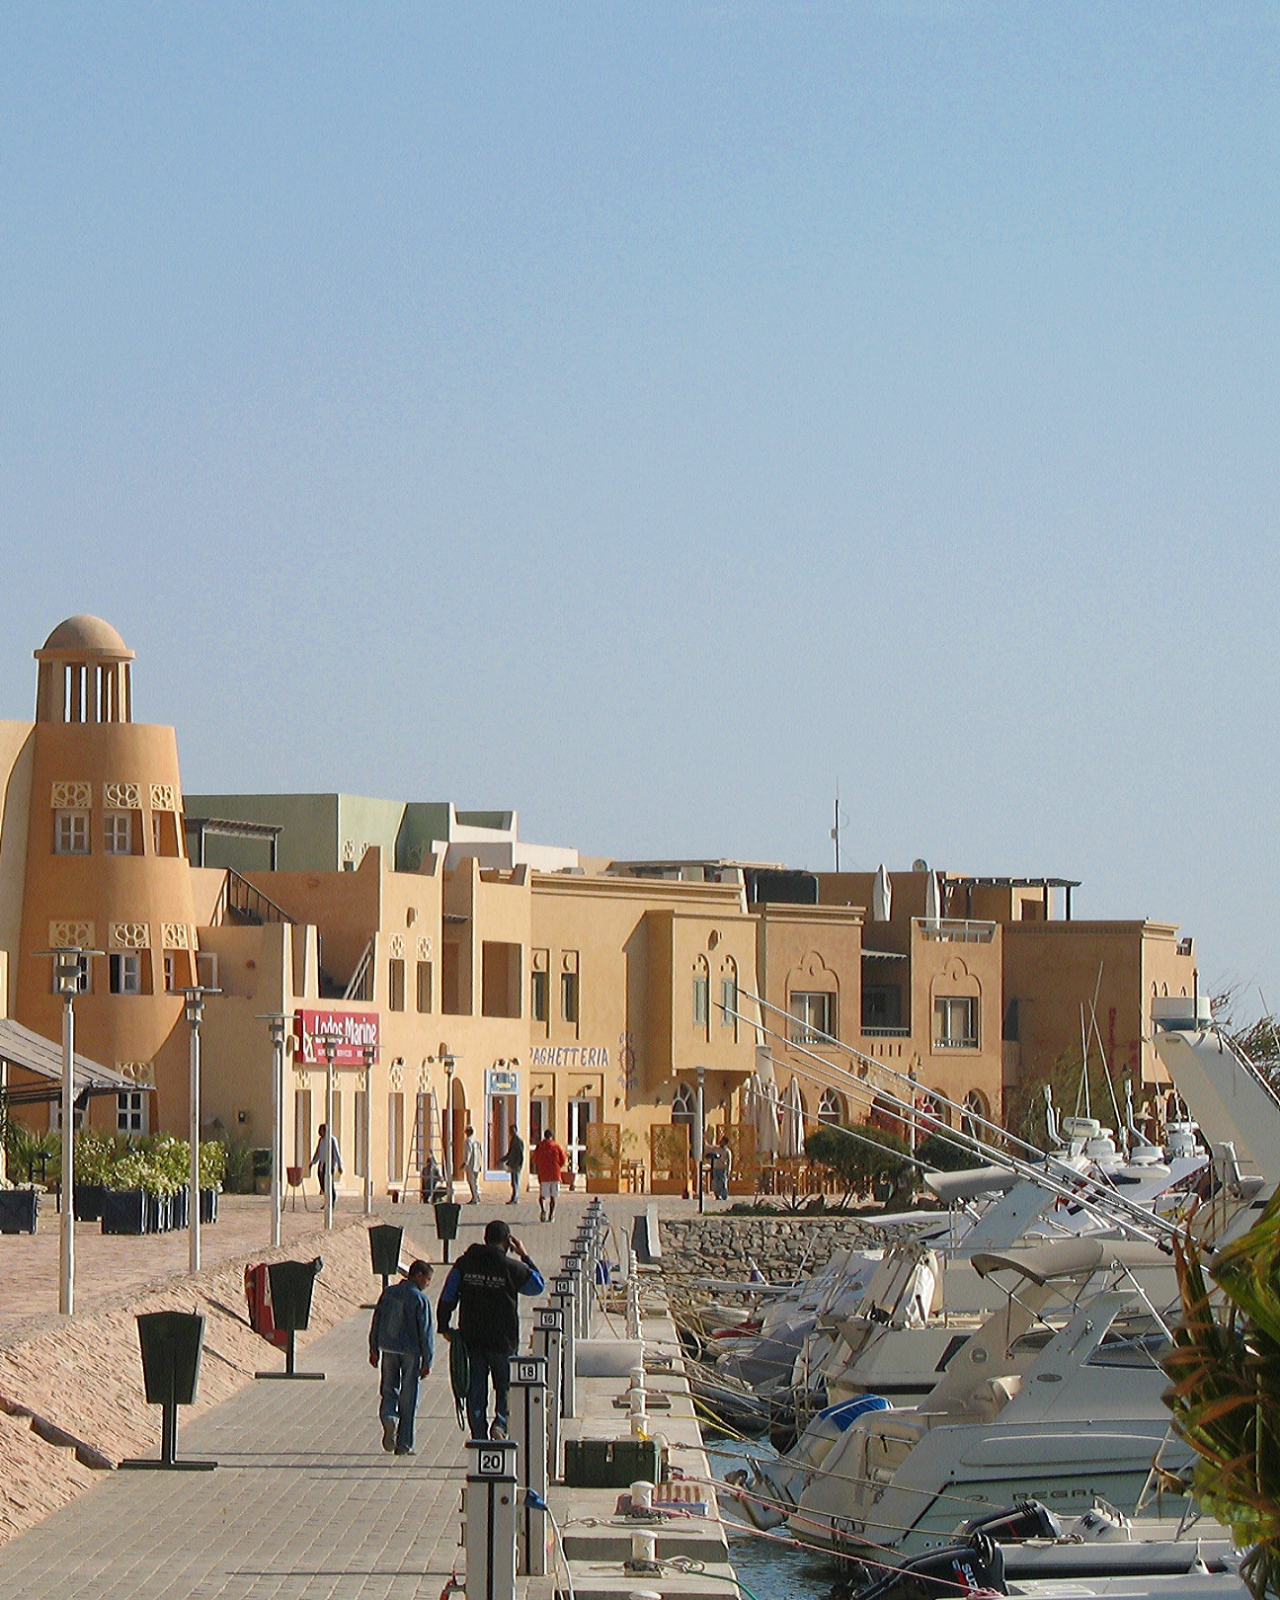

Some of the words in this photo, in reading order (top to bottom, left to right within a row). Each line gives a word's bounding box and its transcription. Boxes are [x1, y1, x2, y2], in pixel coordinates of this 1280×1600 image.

[345, 1016, 377, 1046] Marine
[558, 1282, 567, 1291] 14
[543, 1314, 553, 1324] 16
[522, 1366, 534, 1378] 18
[482, 1455, 501, 1470] 20
[1012, 1488, 1105, 1501] REGAL
[962, 1562, 980, 1593] SUZ
